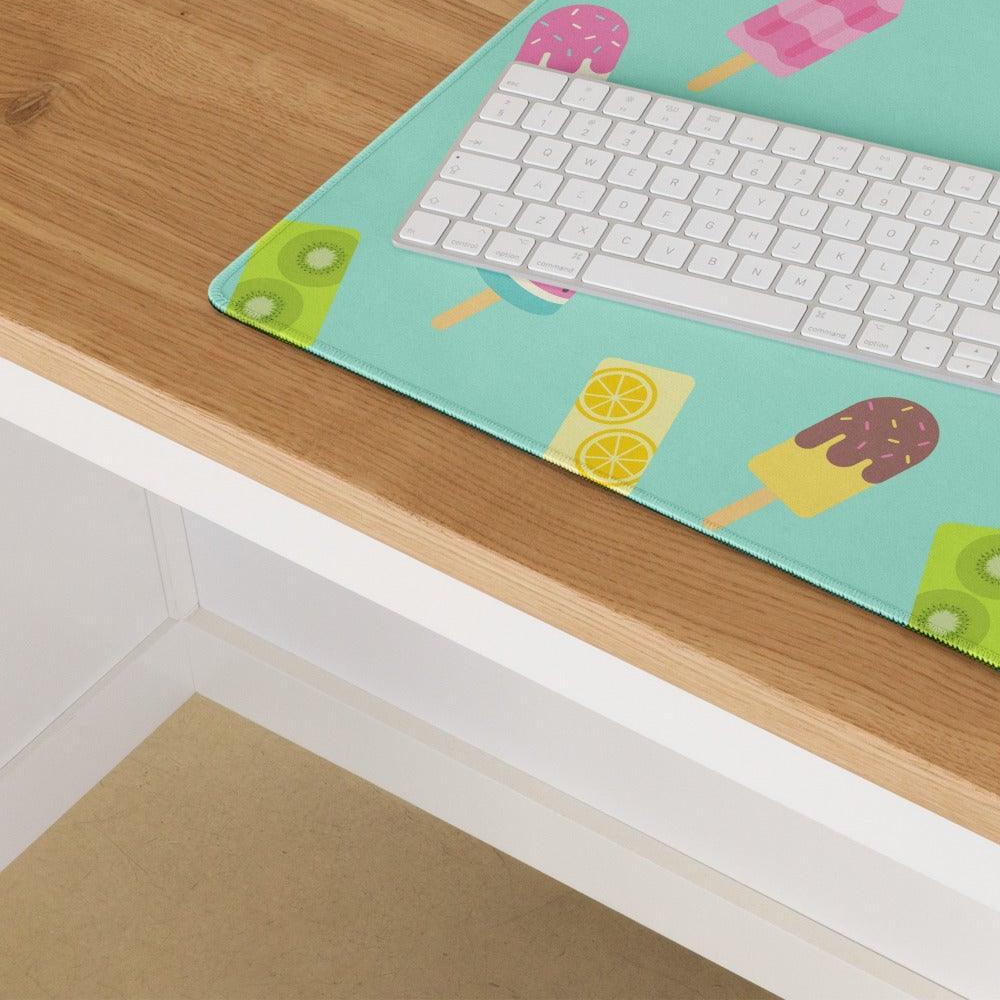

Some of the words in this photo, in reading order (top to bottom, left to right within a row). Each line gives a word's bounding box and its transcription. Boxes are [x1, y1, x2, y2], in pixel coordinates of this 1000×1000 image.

[496, 251, 520, 261] option
[536, 260, 575, 273] command
[807, 327, 847, 339] command
[863, 338, 889, 350] option
